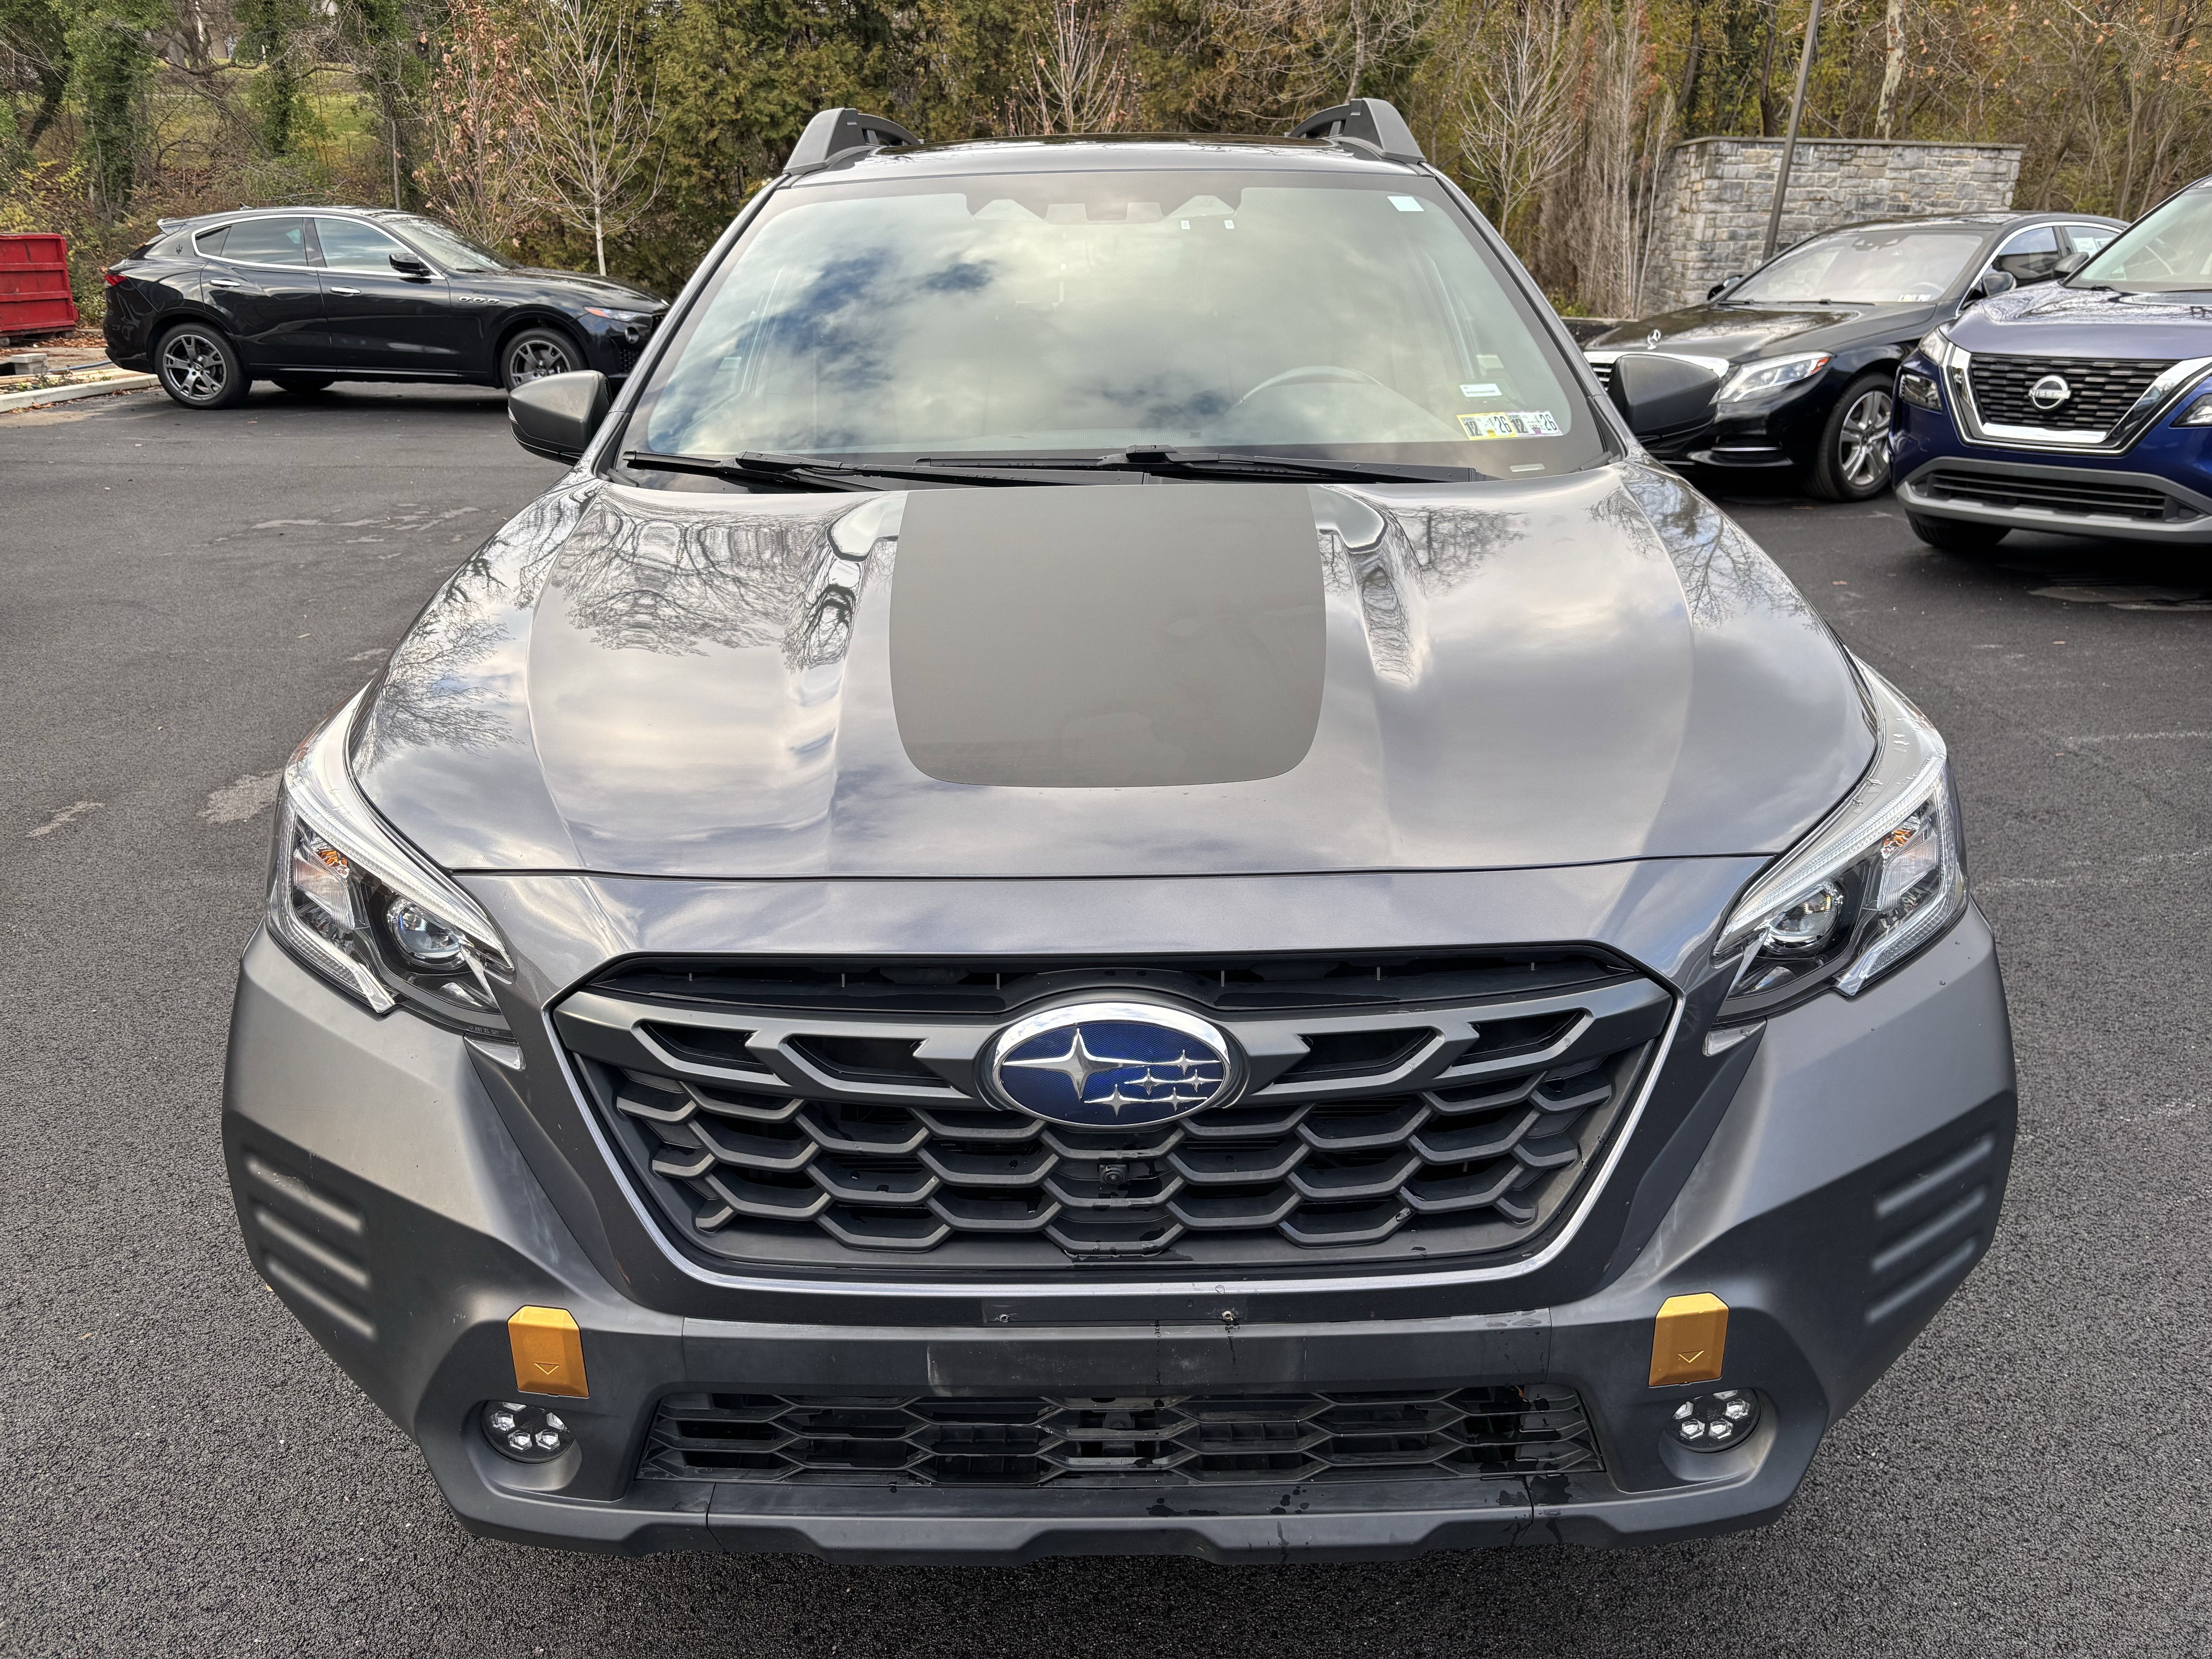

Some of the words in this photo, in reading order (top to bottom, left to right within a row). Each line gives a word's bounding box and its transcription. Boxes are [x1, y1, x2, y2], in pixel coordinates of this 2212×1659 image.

[2029, 390, 2069, 398] NISSA
[1464, 421, 1483, 436] 12
[1494, 416, 1512, 433] 26
[1511, 419, 1528, 433] 12
[1539, 414, 1557, 430] 26
